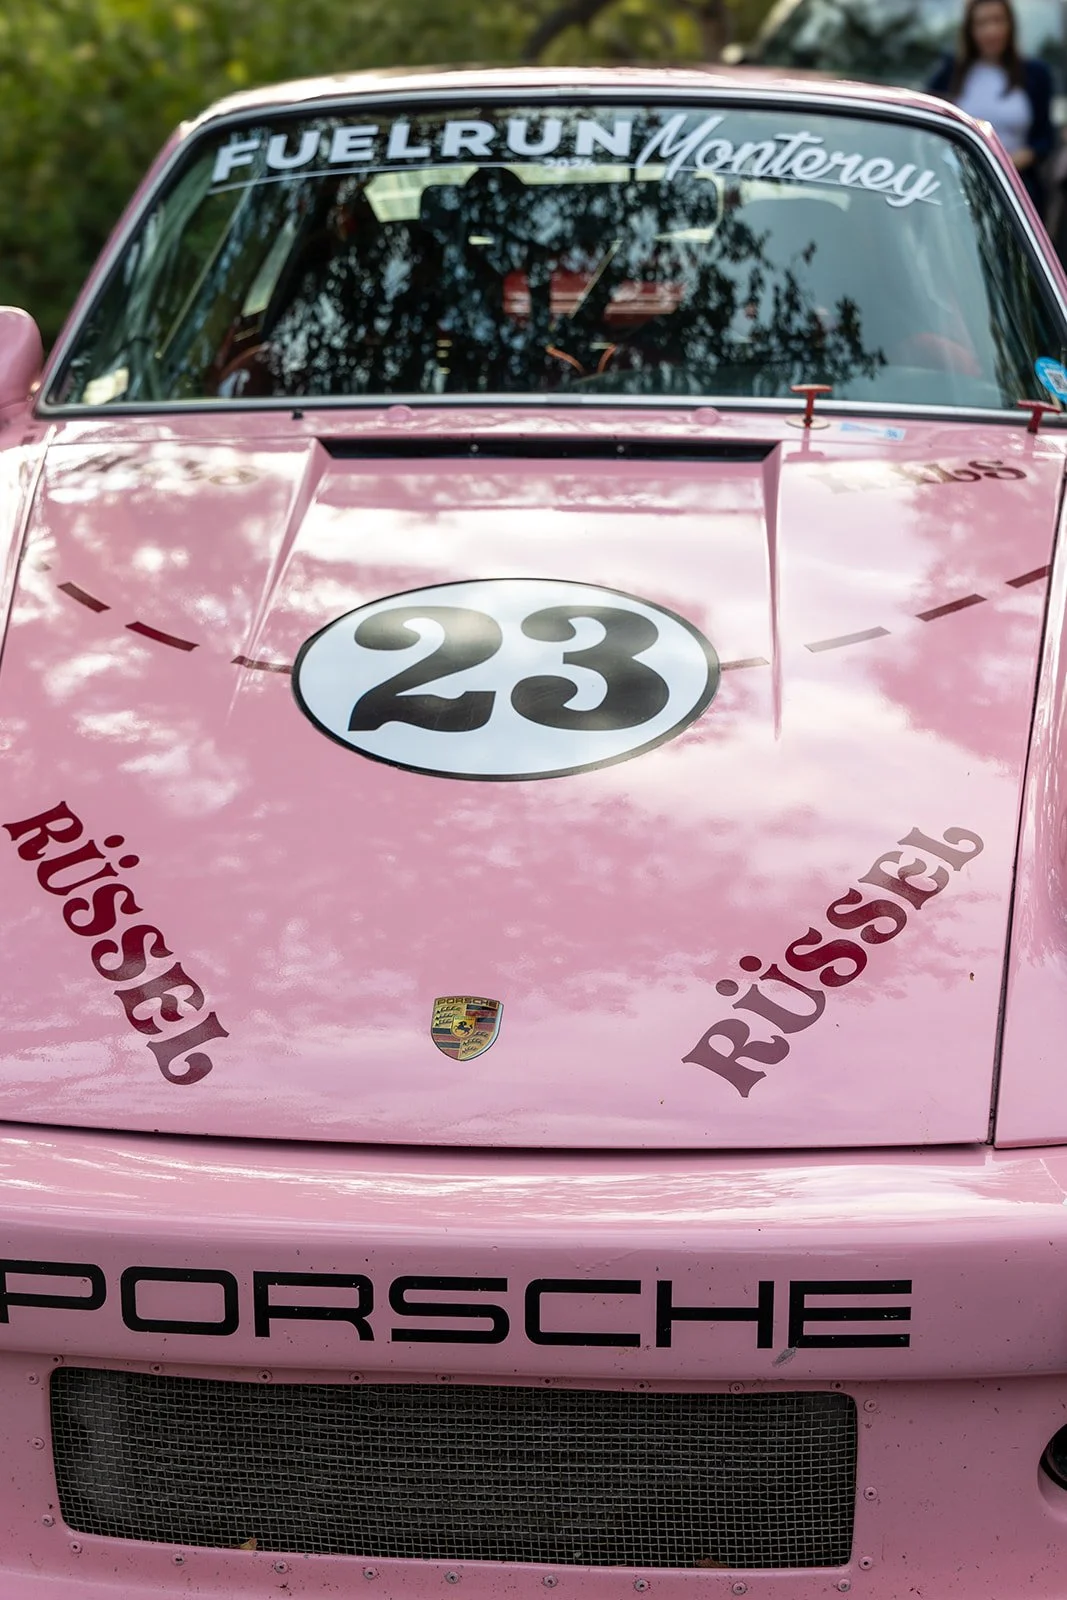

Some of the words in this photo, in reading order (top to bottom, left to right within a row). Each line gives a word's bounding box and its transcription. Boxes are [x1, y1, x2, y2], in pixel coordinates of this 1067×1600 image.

[212, 118, 633, 183] FUELRUN
[634, 113, 942, 207] Monterey
[347, 604, 671, 733] 23
[2, 801, 230, 1086] RÜSSEL
[681, 826, 985, 1098] RÜSSEL
[437, 997, 499, 1008] PORSCHE
[0, 1258, 913, 1350] PORSCHE
